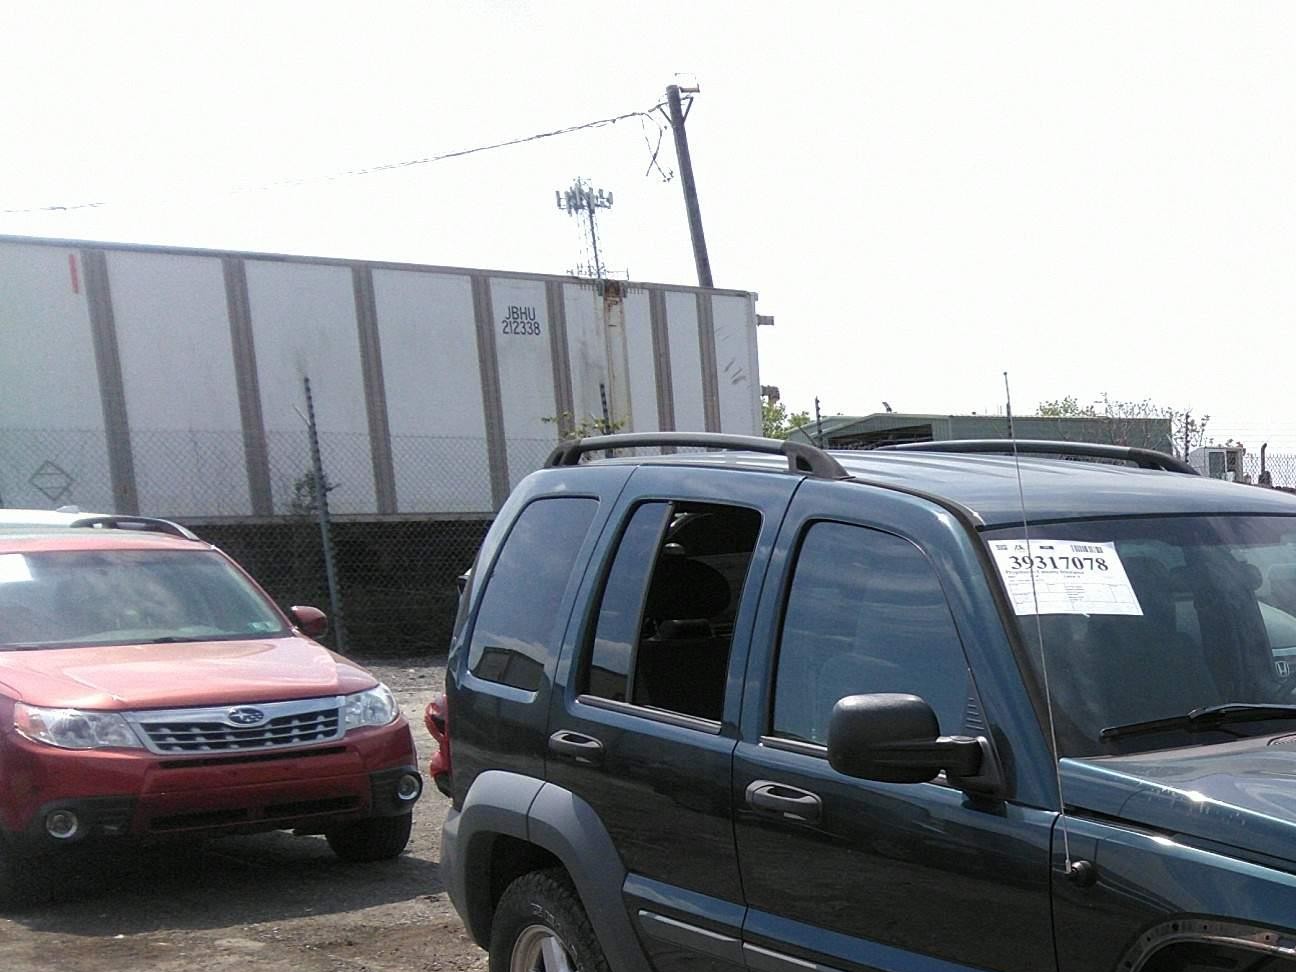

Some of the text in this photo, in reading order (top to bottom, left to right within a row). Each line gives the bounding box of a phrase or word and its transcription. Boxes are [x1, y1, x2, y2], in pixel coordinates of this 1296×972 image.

[505, 305, 536, 321] JBHU
[502, 319, 541, 336] 212338
[1008, 555, 1109, 571] 39317078
